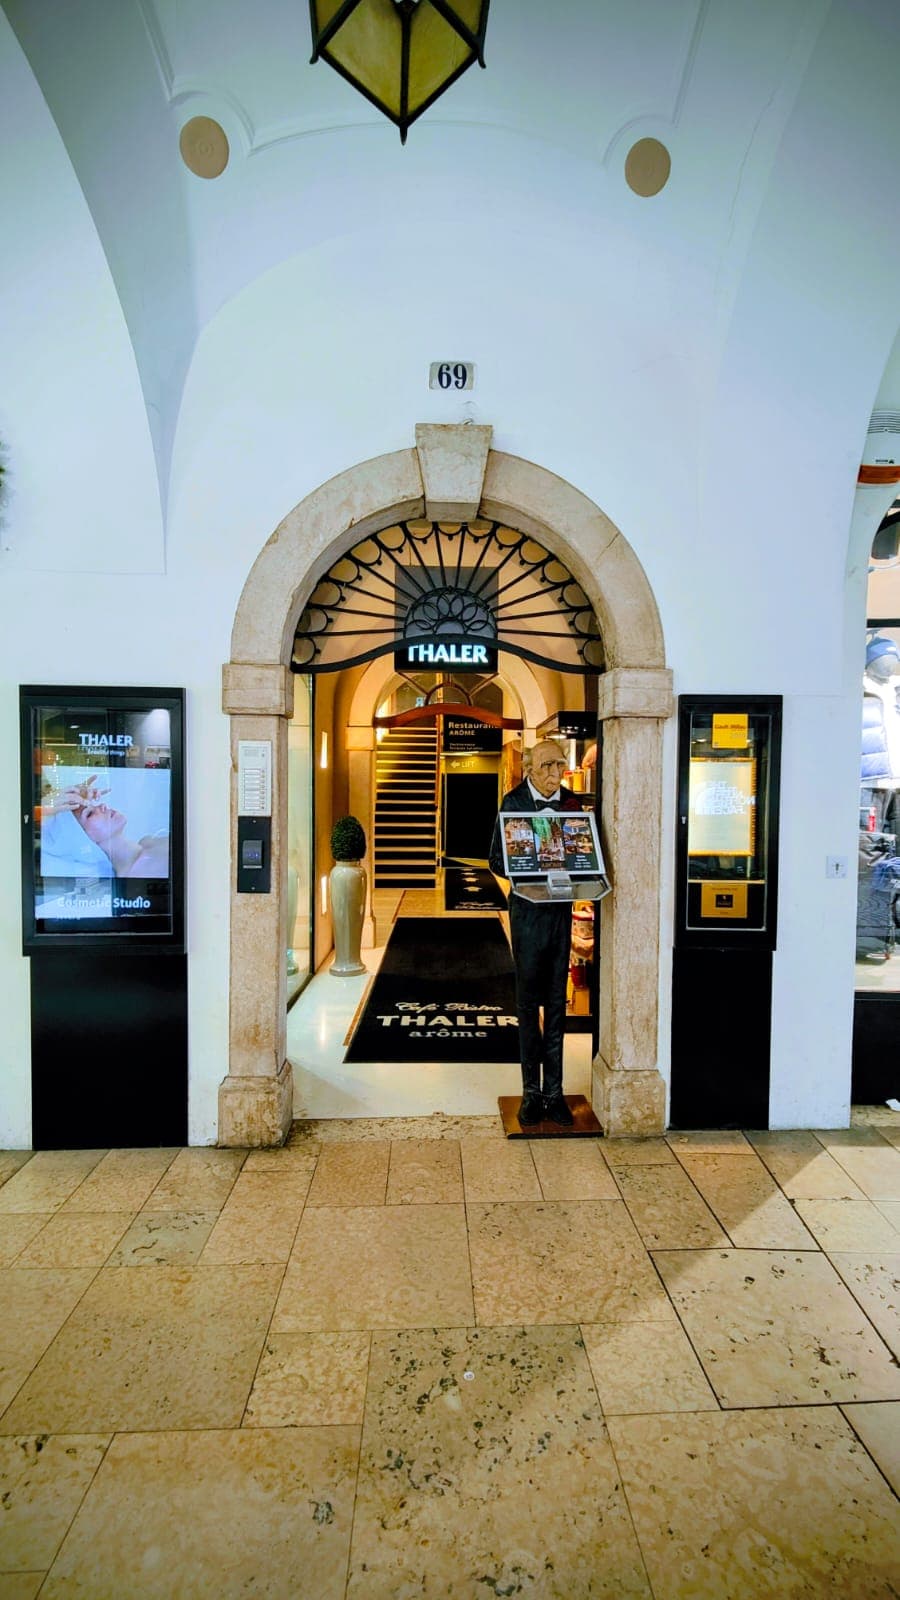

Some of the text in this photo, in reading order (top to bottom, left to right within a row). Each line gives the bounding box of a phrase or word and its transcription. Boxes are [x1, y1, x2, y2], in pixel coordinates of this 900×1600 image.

[438, 363, 467, 389] 69
[408, 644, 489, 663] THALER
[79, 733, 133, 747] THALER
[57, 895, 151, 909] Cosmetic Studio
[444, 1002, 504, 1012] Bistro
[376, 1015, 520, 1027] THALER
[408, 1028, 488, 1038] arôme
